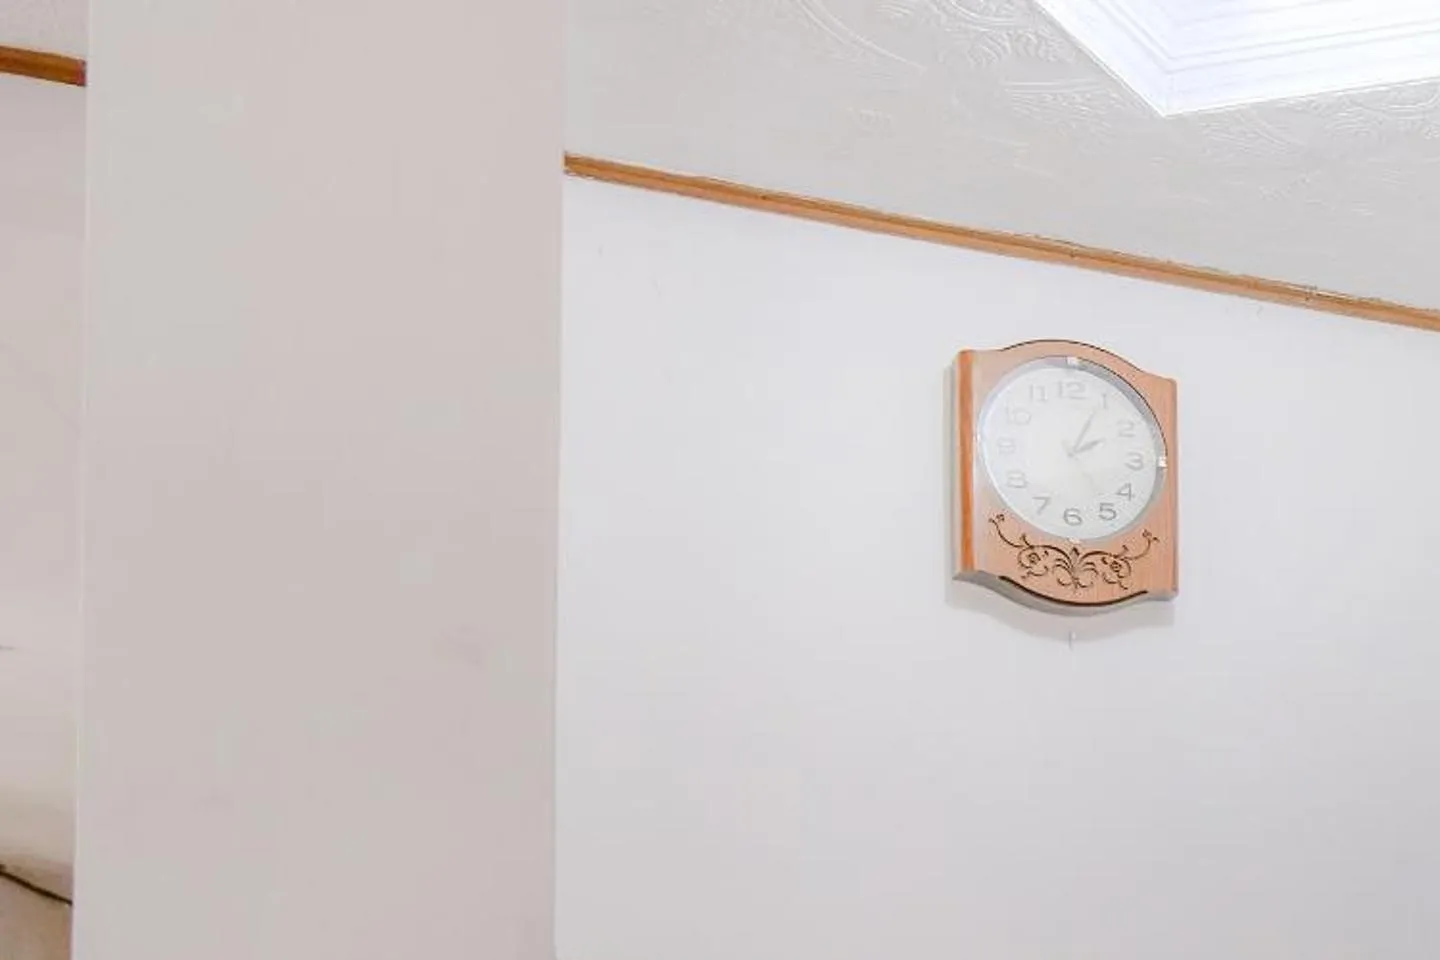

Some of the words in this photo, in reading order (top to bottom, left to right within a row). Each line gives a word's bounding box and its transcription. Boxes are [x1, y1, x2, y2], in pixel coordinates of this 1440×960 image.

[1029, 384, 1049, 402] 11
[1059, 380, 1087, 400] 12
[1005, 404, 1032, 426] 10
[1117, 420, 1137, 438] 2
[997, 437, 1015, 455] 9
[1124, 452, 1145, 472] 3
[1006, 470, 1029, 489] 8
[1116, 483, 1134, 501] 4
[1032, 495, 1052, 516] 7
[1099, 502, 1118, 521] 5
[1063, 507, 1083, 526] 6
